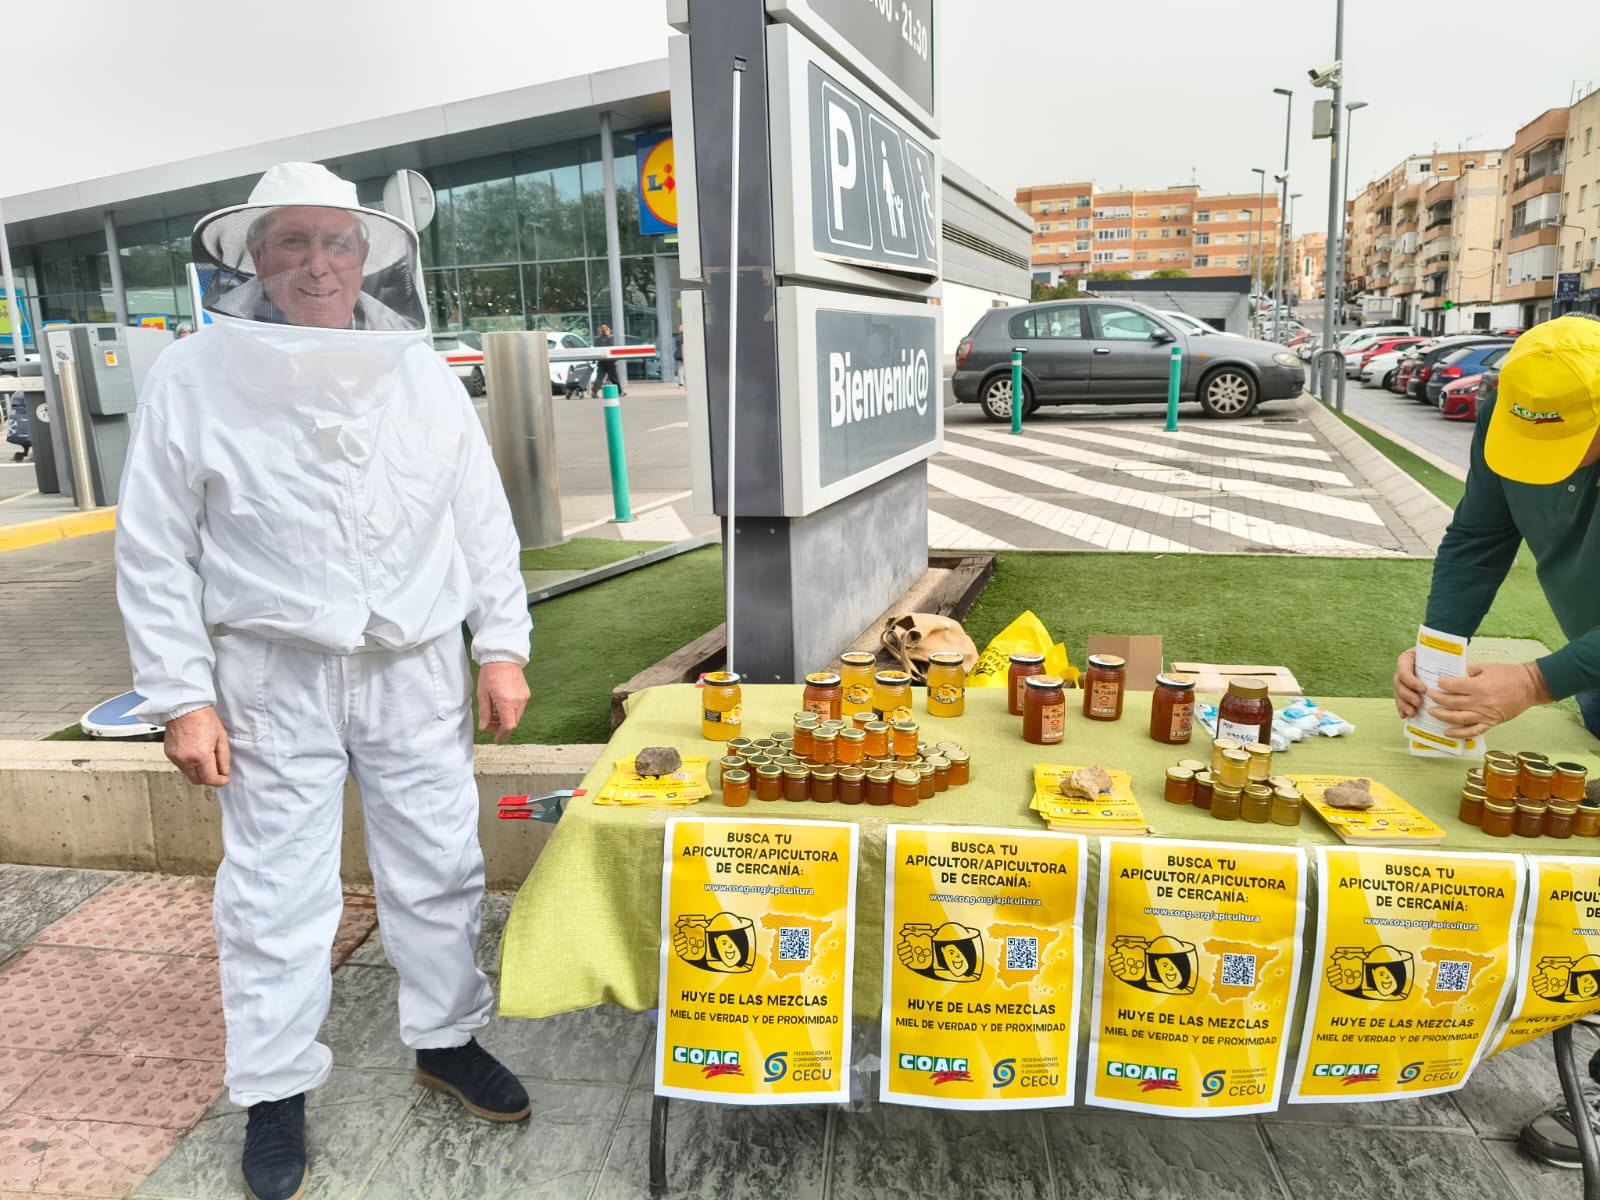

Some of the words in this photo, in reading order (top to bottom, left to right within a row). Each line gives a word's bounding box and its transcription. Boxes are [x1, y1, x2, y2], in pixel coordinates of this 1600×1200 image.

[902, 2, 927, 60] 21:30
[828, 101, 857, 231] P
[829, 349, 928, 427] Bienvenid@
[1512, 402, 1558, 419] COAG
[727, 832, 770, 844] BUSCA
[775, 834, 792, 844] TU
[682, 846, 839, 862] APICULTOR/APICULTORA
[951, 842, 995, 854] BUSCA
[1000, 844, 1018, 855] TU
[716, 862, 731, 873] DE
[736, 862, 804, 876] CERCANÍA:
[906, 855, 1067, 874] APICULTOR/APICULTORA
[1168, 856, 1213, 869] BUSCA
[1218, 859, 1236, 870] TU
[1385, 864, 1431, 878] BUSCA
[1436, 868, 1454, 878] TU
[942, 872, 956, 883] DE
[962, 873, 1031, 888] CERCANÍA:
[1120, 868, 1286, 890] APICULTOR/APICULTORA
[704, 884, 814, 896] www.coag.org/apicultura
[1157, 886, 1173, 898] DE
[1178, 887, 1248, 903] CERCANÍA:
[1339, 878, 1505, 898] APICULTOR/APICULTORA
[929, 893, 1041, 906] www.coag.org/apicultura
[1376, 896, 1392, 906] DE
[1397, 896, 1468, 911] CERCANÍA:
[1550, 890, 1600, 902] APICUL
[1144, 907, 1260, 923] www.coag.org/apicultura
[1587, 907, 1600, 917] DE
[1364, 917, 1478, 931] www.coag.org/apicultura
[682, 990, 715, 1003] HUYE
[719, 993, 734, 1004] DE
[739, 994, 763, 1006] LAS
[768, 995, 828, 1006] MEZCLAS
[908, 998, 942, 1012] HUYE
[947, 1002, 963, 1013] DE
[968, 1003, 991, 1014] LAS
[996, 1004, 1056, 1015] MEZCLAS
[670, 1009, 692, 1020] MIEL
[694, 1012, 706, 1020] DE
[709, 1013, 748, 1024] VERDAD
[752, 1015, 758, 1024] Y
[762, 1016, 774, 1024] DE
[778, 1016, 838, 1025] PROXIMIDAD
[896, 1017, 919, 1028] MIEL
[922, 1020, 934, 1029] DE
[938, 1021, 977, 1032] VERDAD
[981, 1023, 988, 1032] Y
[990, 1023, 1002, 1032] DE
[1006, 1023, 1066, 1032] PROXIMIDAD
[1118, 1009, 1155, 1023] HUYE
[1158, 1014, 1175, 1024] DE
[1180, 1015, 1204, 1027] LAS
[1208, 1017, 1269, 1029] MEZCLAS
[1330, 1016, 1366, 1027] HUYE
[1370, 1018, 1386, 1027] DE
[1389, 1018, 1413, 1028] LAS
[1416, 1018, 1475, 1028] MEZCLAS
[1105, 1026, 1128, 1037] MIEL
[1132, 1029, 1144, 1038] DE
[1148, 1032, 1188, 1042] VERDAD
[1192, 1035, 1199, 1043] Y
[1202, 1036, 1214, 1045] DE
[1218, 1036, 1277, 1046] PROXIMIDAD
[1316, 1034, 1339, 1042] MIEL
[1358, 1034, 1396, 1043] VERDAD
[1422, 1033, 1479, 1042] PROXIMIDAD
[674, 1046, 739, 1065] COAG
[900, 1054, 968, 1072] COAG
[792, 1069, 832, 1081] CECU
[1108, 1061, 1178, 1080] COAG
[1313, 1064, 1380, 1076] COAG
[1423, 1071, 1460, 1082] CECU
[1020, 1074, 1058, 1087] CECU
[1229, 1084, 1266, 1097] CECU
